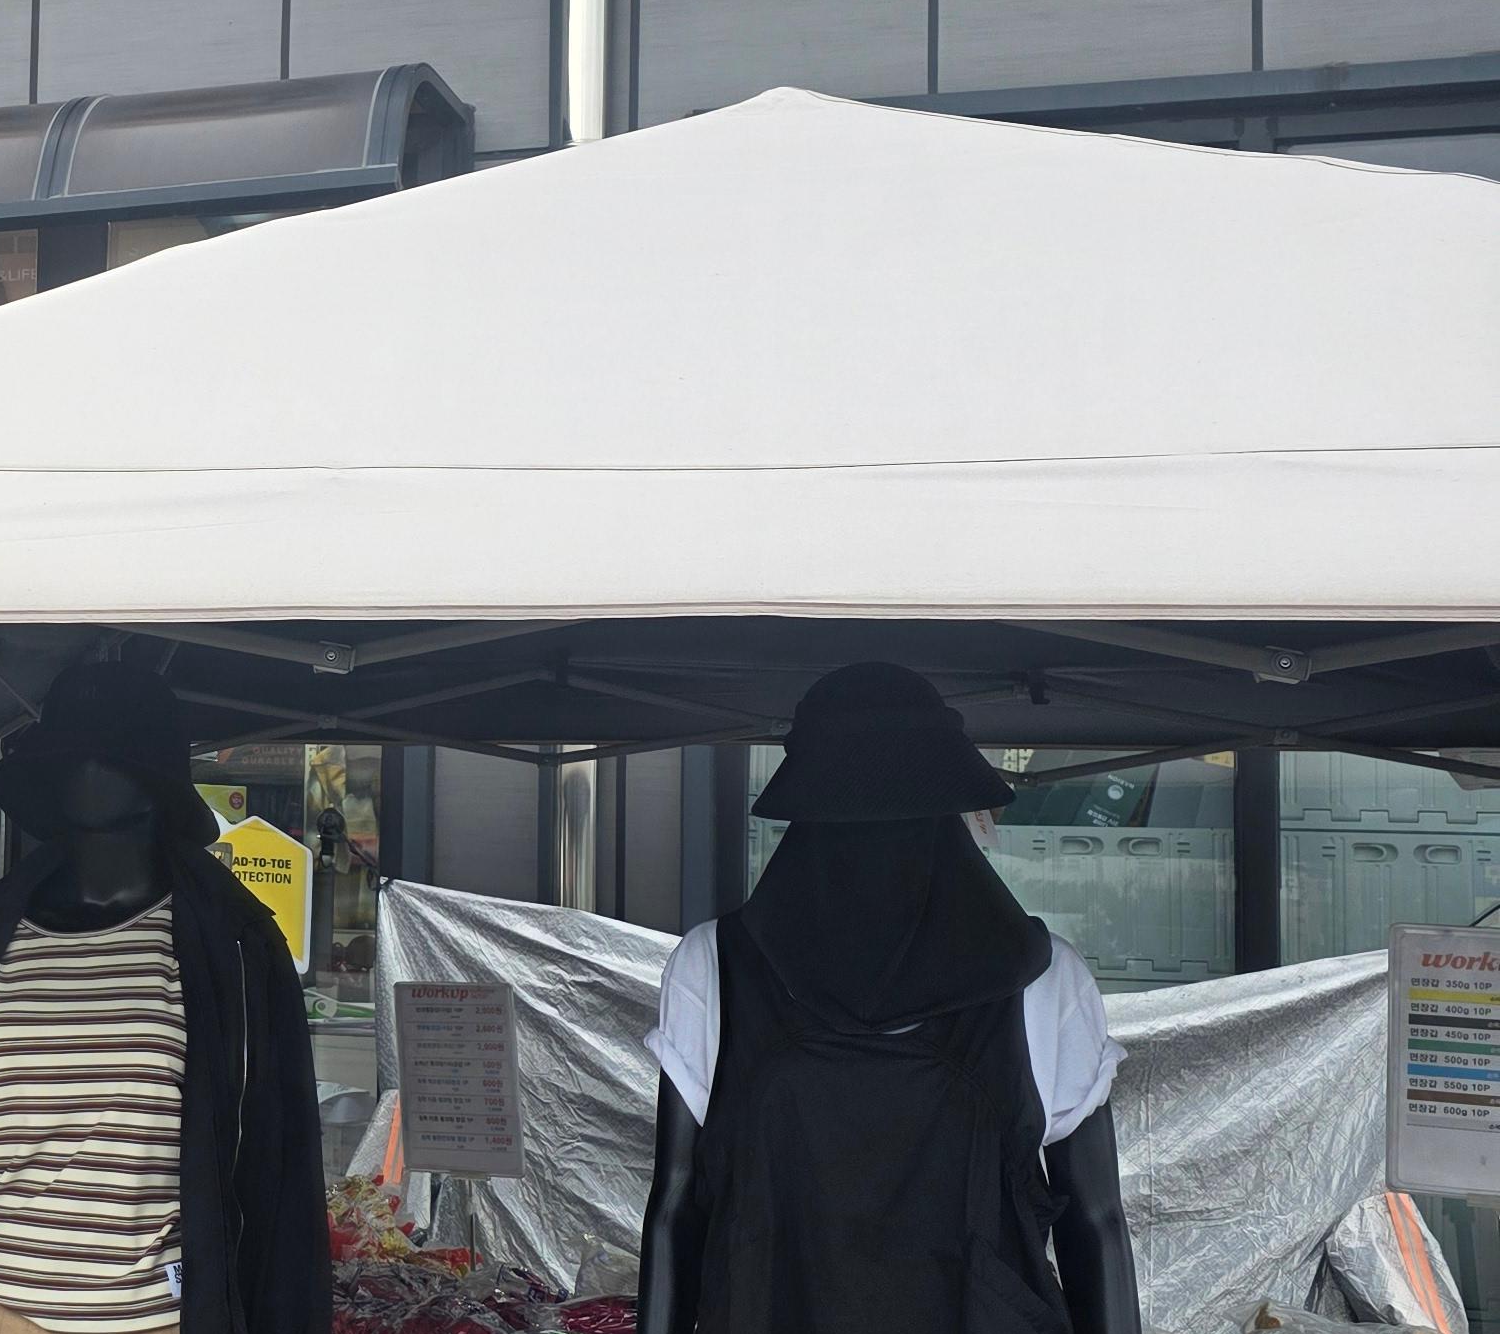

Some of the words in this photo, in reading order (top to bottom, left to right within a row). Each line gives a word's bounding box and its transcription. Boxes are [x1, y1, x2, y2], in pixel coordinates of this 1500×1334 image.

[232, 856, 292, 869] AD-TO-TOE
[234, 870, 292, 884] OTECTION
[1421, 951, 1500, 972] work
[1445, 980, 1470, 990] 350g
[1473, 981, 1492, 990] 10P
[1445, 1005, 1470, 1015] 400g
[1473, 1007, 1492, 1016] 10P
[1445, 1030, 1469, 1040] 450g
[1473, 1032, 1491, 1041] 10P
[1443, 1055, 1469, 1066] 500g
[1472, 1057, 1491, 1066] 10P
[1443, 1081, 1468, 1092] 550g
[1472, 1083, 1491, 1092] 10P
[1443, 1106, 1468, 1117] 600g
[1472, 1109, 1490, 1117] 10P
